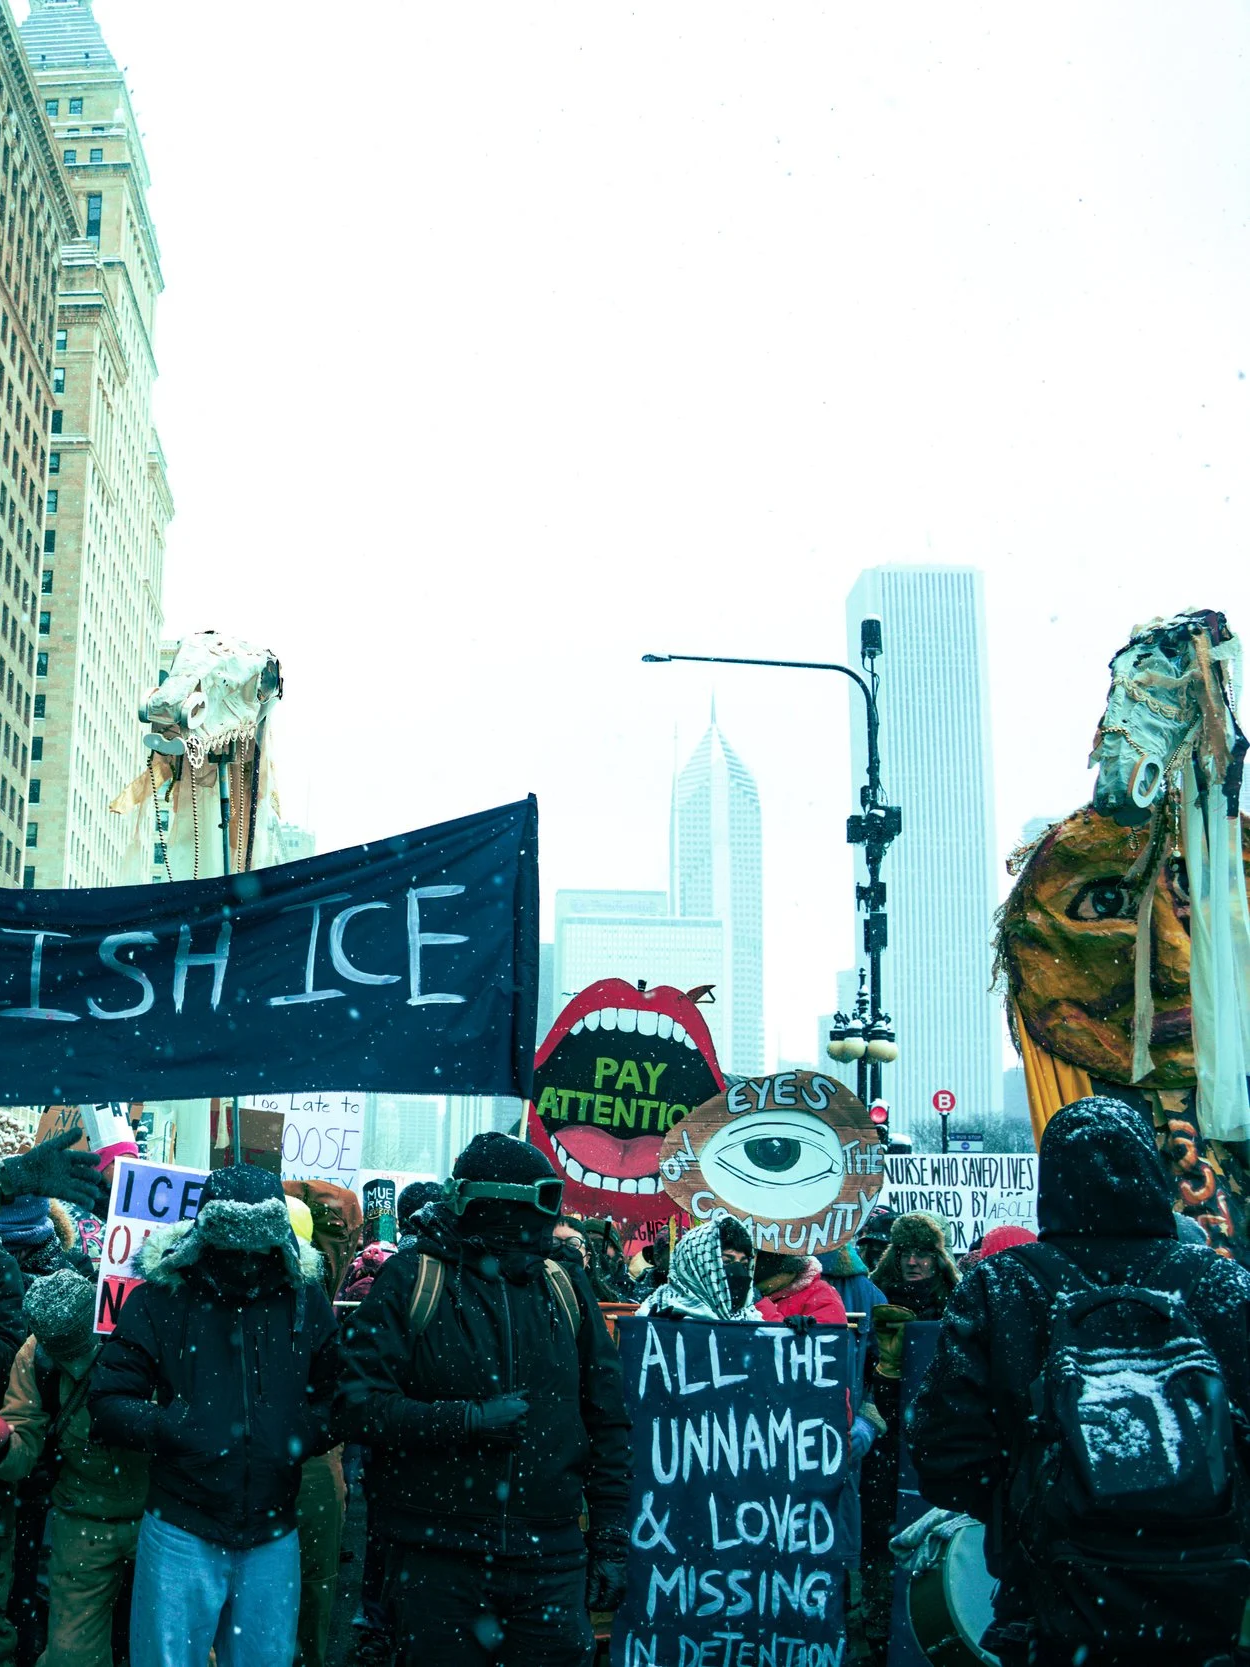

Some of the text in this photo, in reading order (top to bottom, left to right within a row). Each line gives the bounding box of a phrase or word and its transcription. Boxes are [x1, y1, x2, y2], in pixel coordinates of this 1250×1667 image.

[269, 885, 469, 1007] ICE
[594, 1057, 668, 1095] PAY
[726, 1073, 837, 1114] EYES
[290, 1094, 330, 1113] Late
[342, 1096, 359, 1114] to
[536, 1086, 690, 1132] ATTENTIO
[938, 1094, 950, 1108] B
[281, 1123, 359, 1171] OOSE
[661, 1129, 699, 1182] ON
[842, 1139, 885, 1175] THE
[367, 1186, 394, 1201] MUE
[930, 1157, 958, 1187] WHO
[961, 1156, 999, 1188] SAVED
[1000, 1157, 1035, 1191] LIVES
[123, 1171, 205, 1220] ICE
[971, 1190, 988, 1218] BY
[987, 1200, 1034, 1220] ABOLI
[691, 1190, 880, 1256] COMUNITY
[639, 1322, 839, 1399] ALL THE
[652, 1404, 842, 1484] UNNAMED
[632, 1491, 835, 1554] & LOVED
[646, 1564, 833, 1620] MISSING
[625, 1627, 846, 1667] IN DETENTION
